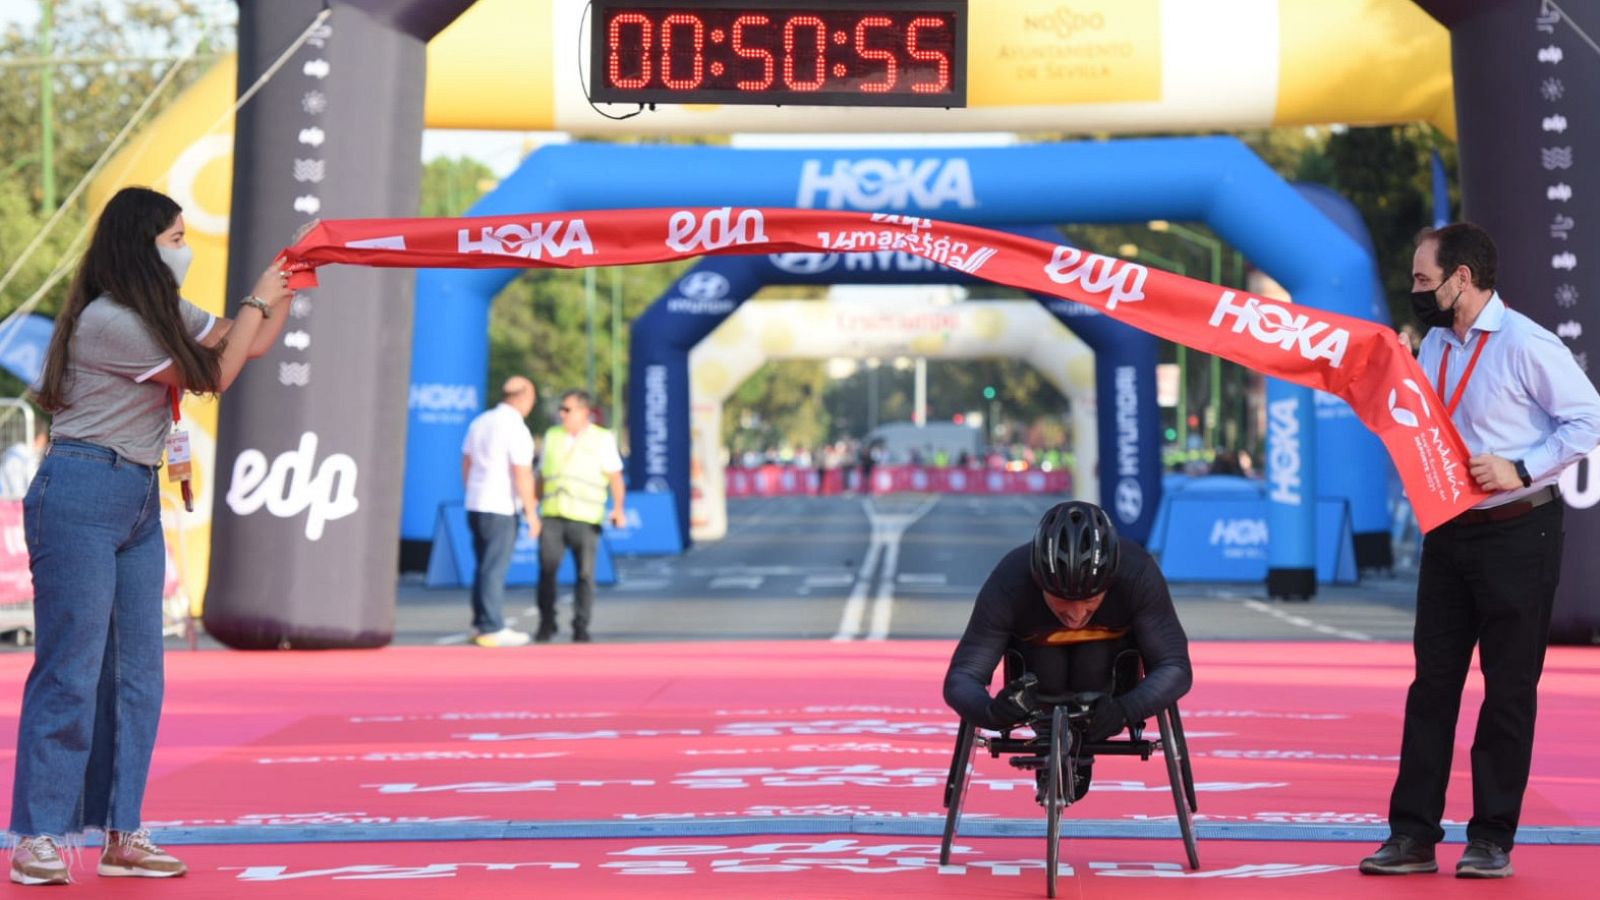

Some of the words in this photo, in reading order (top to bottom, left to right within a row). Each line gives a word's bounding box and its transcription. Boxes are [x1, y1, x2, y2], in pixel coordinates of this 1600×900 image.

[608, 13, 949, 94] 00:50:55
[796, 158, 976, 210] HOKA
[457, 218, 595, 261] HOKA
[1043, 244, 1149, 311] edp
[1208, 290, 1351, 368] HOKA
[408, 383, 479, 411] HOKA
[645, 364, 668, 475] HYUNDAI
[1115, 365, 1140, 476] HYUNDAI
[225, 431, 360, 542] edp
[1270, 397, 1302, 507] HOKA
